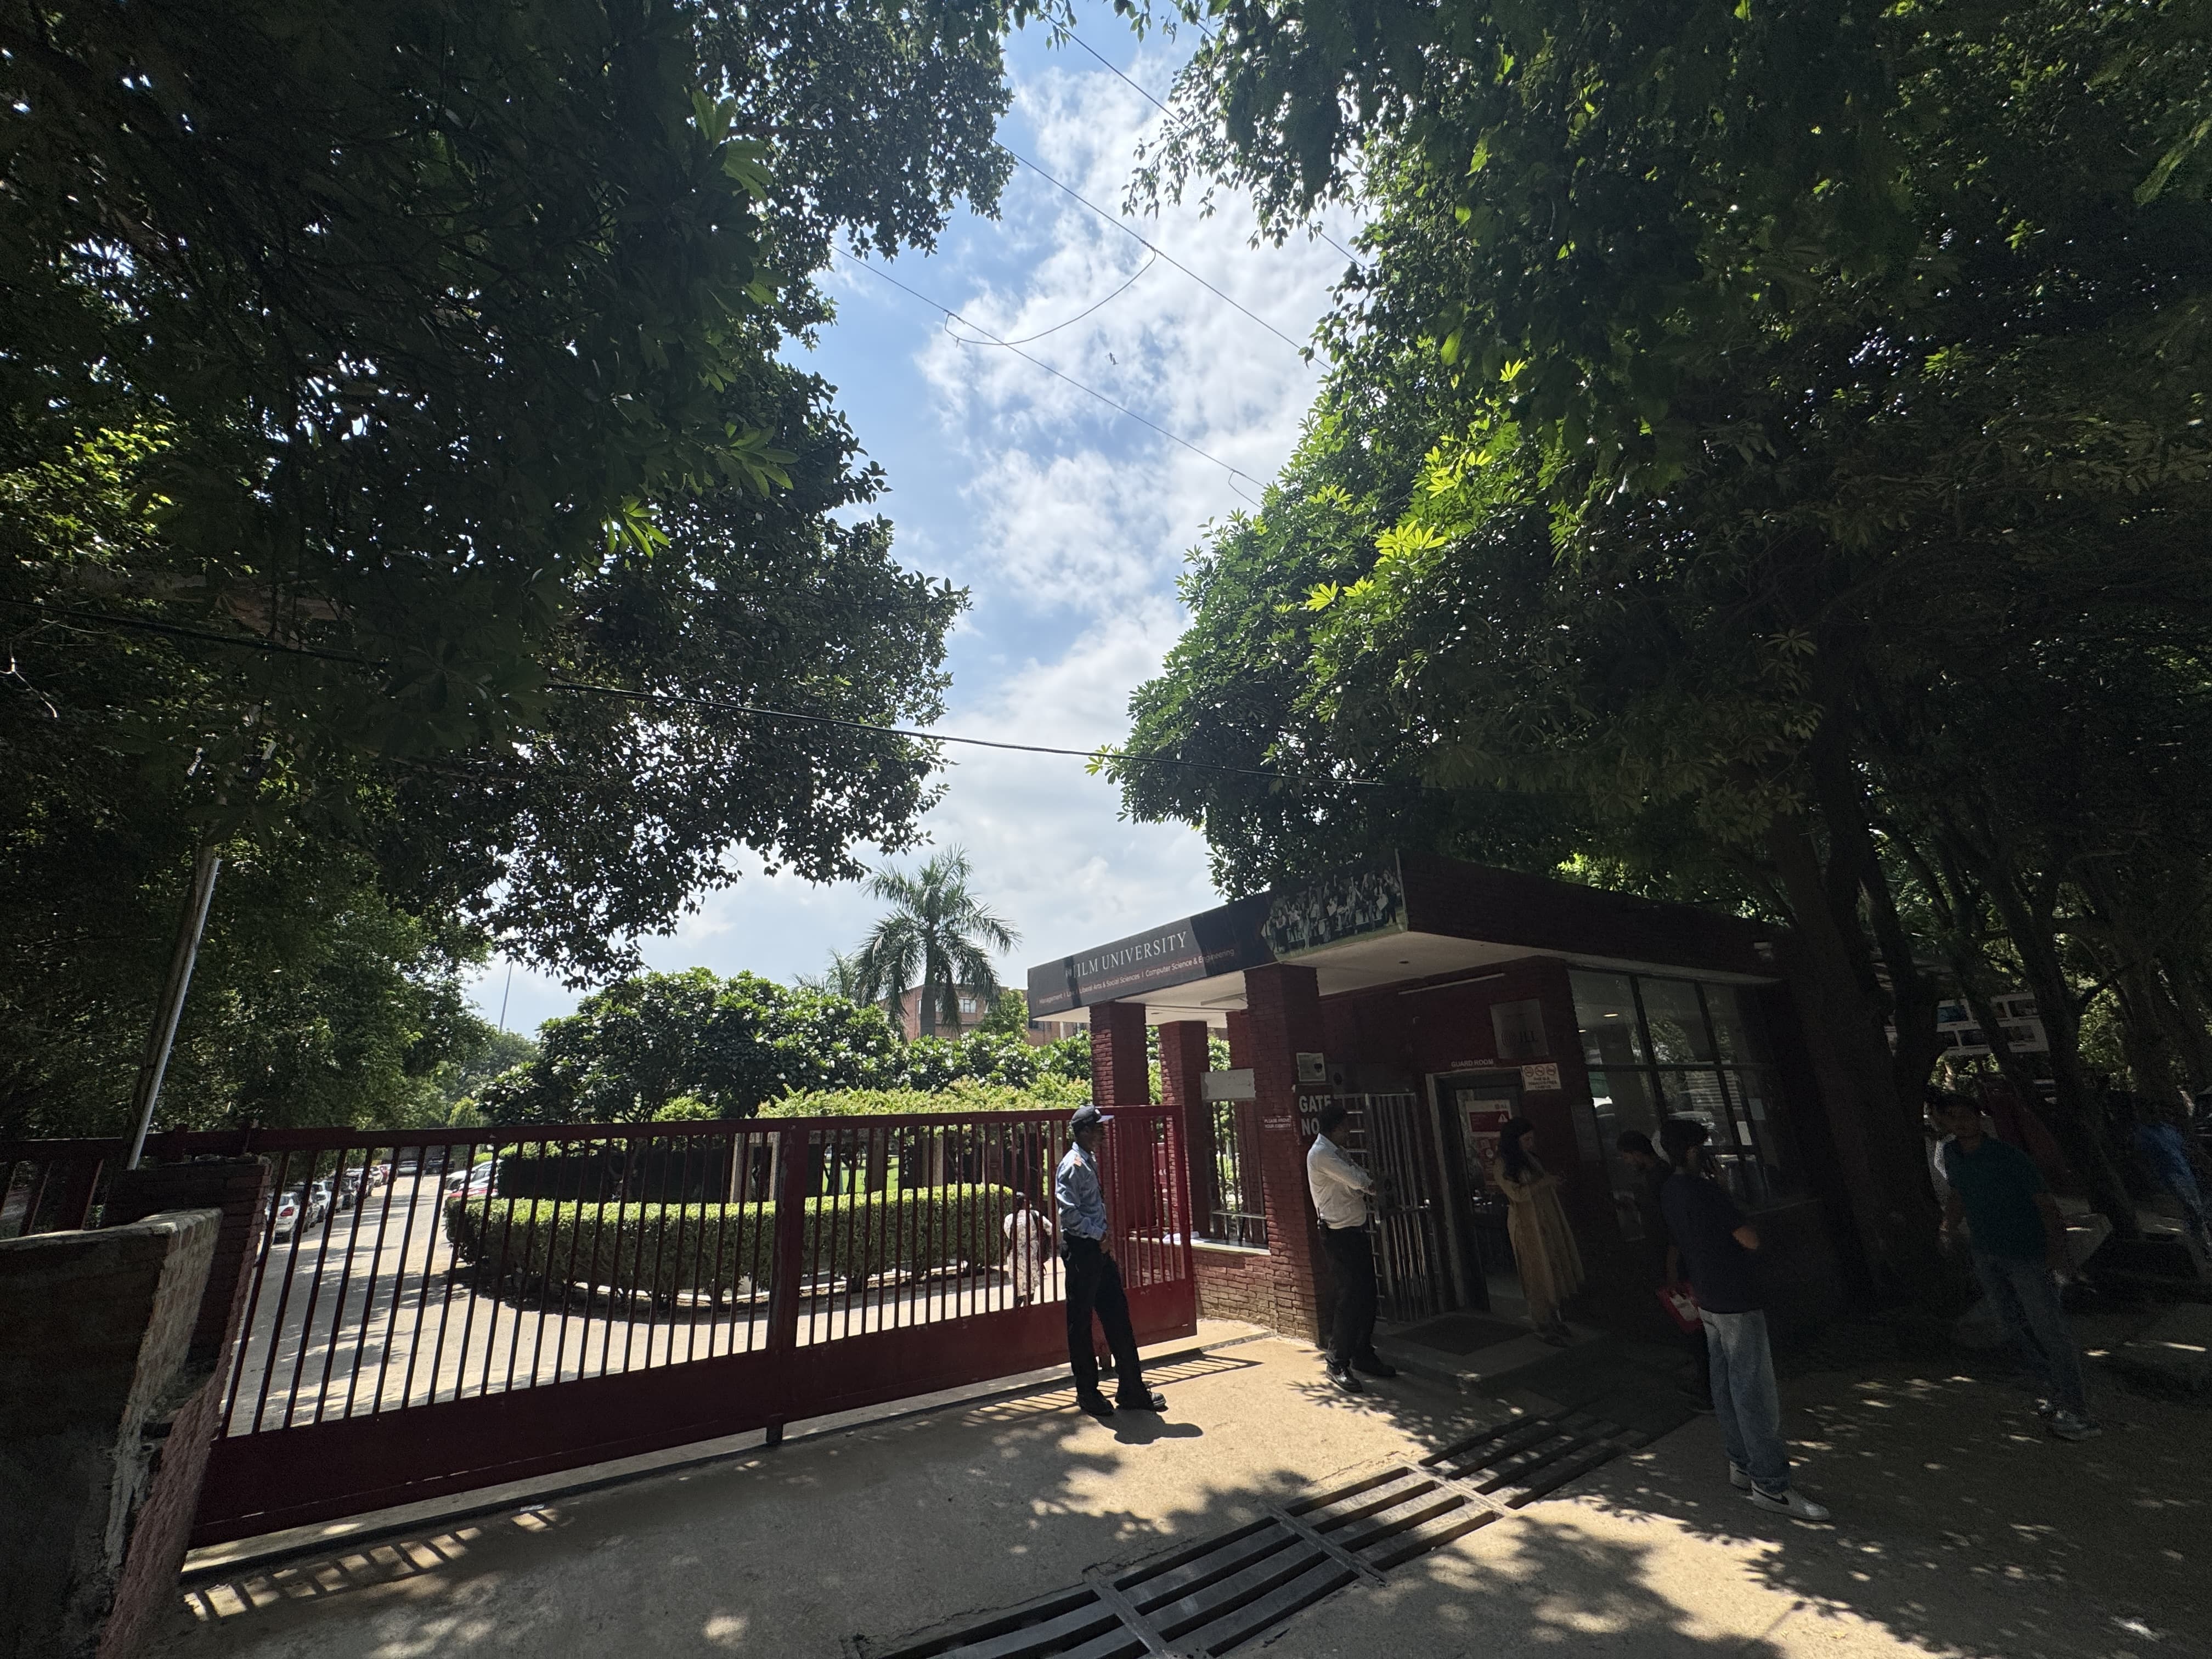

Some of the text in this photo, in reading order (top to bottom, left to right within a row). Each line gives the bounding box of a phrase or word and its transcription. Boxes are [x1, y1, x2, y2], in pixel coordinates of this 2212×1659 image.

[1073, 931, 1187, 979] IILM UNIVERSITY
[1039, 993, 1063, 1005] Management
[1079, 984, 1092, 994] Liberal
[1106, 978, 1119, 987] Social
[1120, 973, 1140, 983] Sciences
[1146, 964, 1171, 978] Computer
[1172, 960, 1192, 970] Science
[1198, 948, 1234, 963] Engineering
[1451, 1059, 1473, 1068] GUARD
[1299, 1094, 1331, 1113] GATE
[1301, 1118, 1319, 1136] NO
